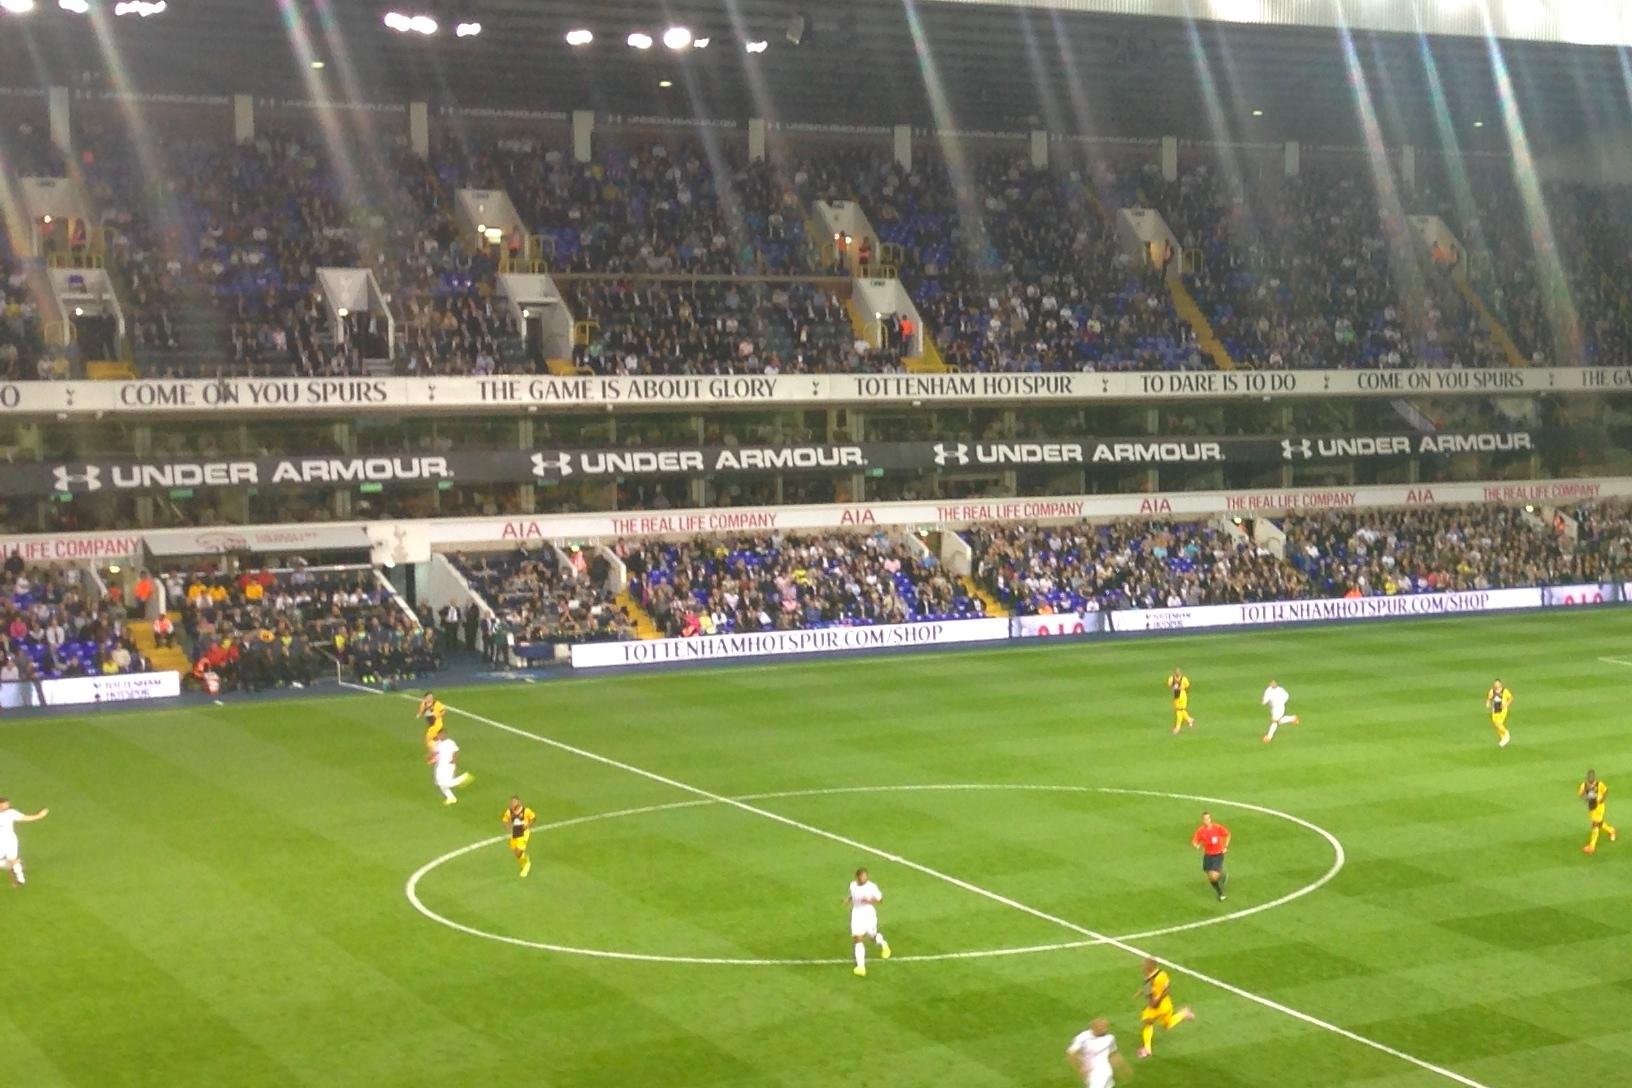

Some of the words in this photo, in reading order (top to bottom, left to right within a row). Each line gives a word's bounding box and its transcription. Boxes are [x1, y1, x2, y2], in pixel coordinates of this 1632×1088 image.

[854, 376, 976, 396] TOTTENHAM
[983, 374, 1074, 394] HOTSPUR
[1140, 374, 1165, 393] TO
[1170, 373, 1216, 392] DARE
[1223, 373, 1237, 392] IS
[1245, 372, 1267, 391] TO
[1270, 372, 1296, 392] DO
[1357, 372, 1404, 390] COME
[1408, 371, 1432, 389] ON
[1435, 370, 1472, 389] YOU
[1473, 370, 1524, 388] SPURS
[1581, 369, 1606, 386] THE
[121, 384, 196, 406] COME
[202, 384, 239, 403] ON
[247, 382, 299, 405] YOU
[307, 381, 388, 404] SPURS
[477, 379, 521, 401] THE
[528, 379, 592, 400] GAME
[601, 379, 620, 400] IS
[627, 378, 703, 399] ABOUT
[708, 377, 777, 399] GLORY
[976, 443, 1083, 463] UNDER
[1318, 437, 1411, 457] UNDER
[580, 451, 704, 474] UNDER
[111, 462, 259, 488] UNDER
[1225, 496, 1248, 509] THE
[1250, 495, 1277, 509] REAL
[1279, 494, 1302, 508] LIFE
[1303, 492, 1357, 507] COMPANY
[1405, 489, 1435, 504] AIA
[1483, 487, 1504, 500] THE
[1505, 486, 1528, 500] REAL
[1530, 485, 1549, 498] LIFE
[1551, 483, 1600, 498] COMPANY
[937, 507, 961, 521] THE
[963, 505, 996, 519] REAL
[999, 503, 1022, 519] LIFE
[1024, 501, 1084, 517] COMPANY
[1139, 499, 1172, 514] AIA
[611, 518, 638, 535] THE
[641, 516, 677, 533] REAL
[680, 515, 704, 532] LIFE
[708, 511, 778, 530] COMPANY
[841, 509, 876, 525] AIA
[502, 521, 542, 540] AIA
[55, 539, 140, 557] COMPANY
[1240, 593, 1489, 623] TOTTENHAMHOTSPUR.COM/SHOP
[622, 625, 944, 662] TOTTENHAMHOTSPUR.COM/SHOP
